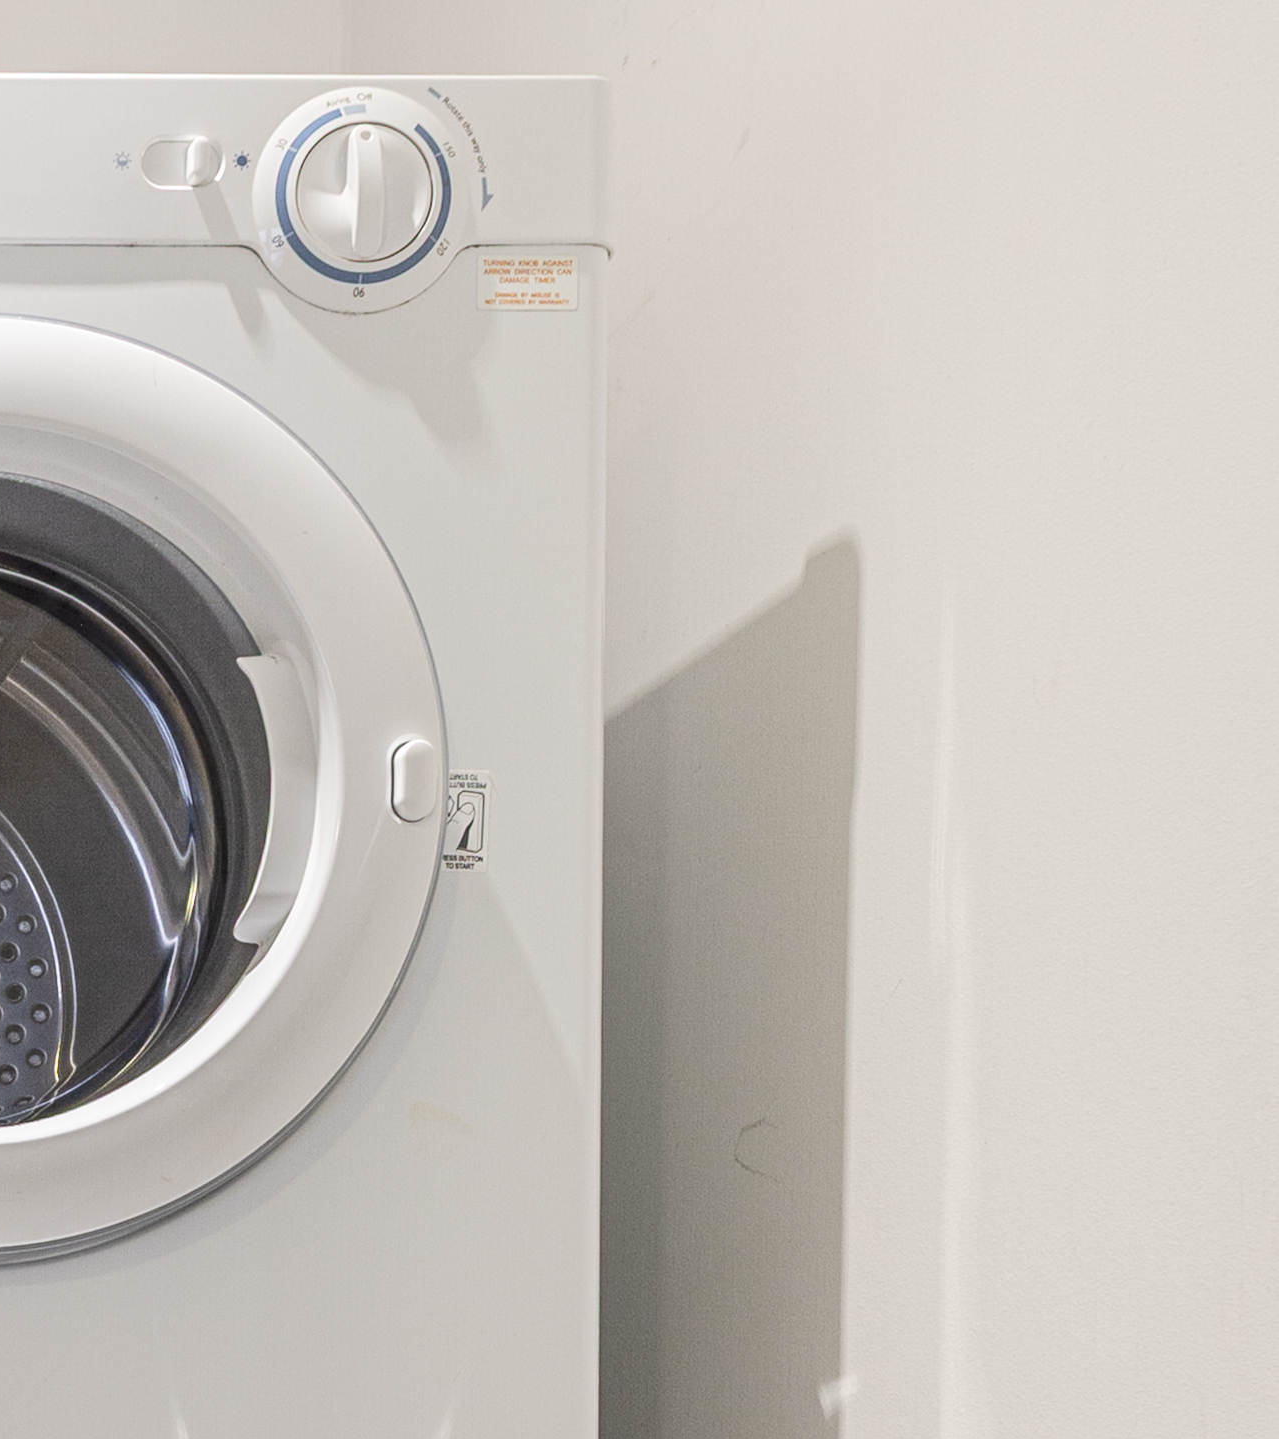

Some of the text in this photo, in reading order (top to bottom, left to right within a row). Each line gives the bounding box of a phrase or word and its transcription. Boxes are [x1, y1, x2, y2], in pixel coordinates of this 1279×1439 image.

[357, 92, 373, 101] Off
[275, 138, 288, 151] 30
[442, 141, 456, 158] 150
[462, 121, 473, 137] this
[471, 137, 480, 153] way
[477, 155, 487, 174] only
[436, 238, 451, 257] 120
